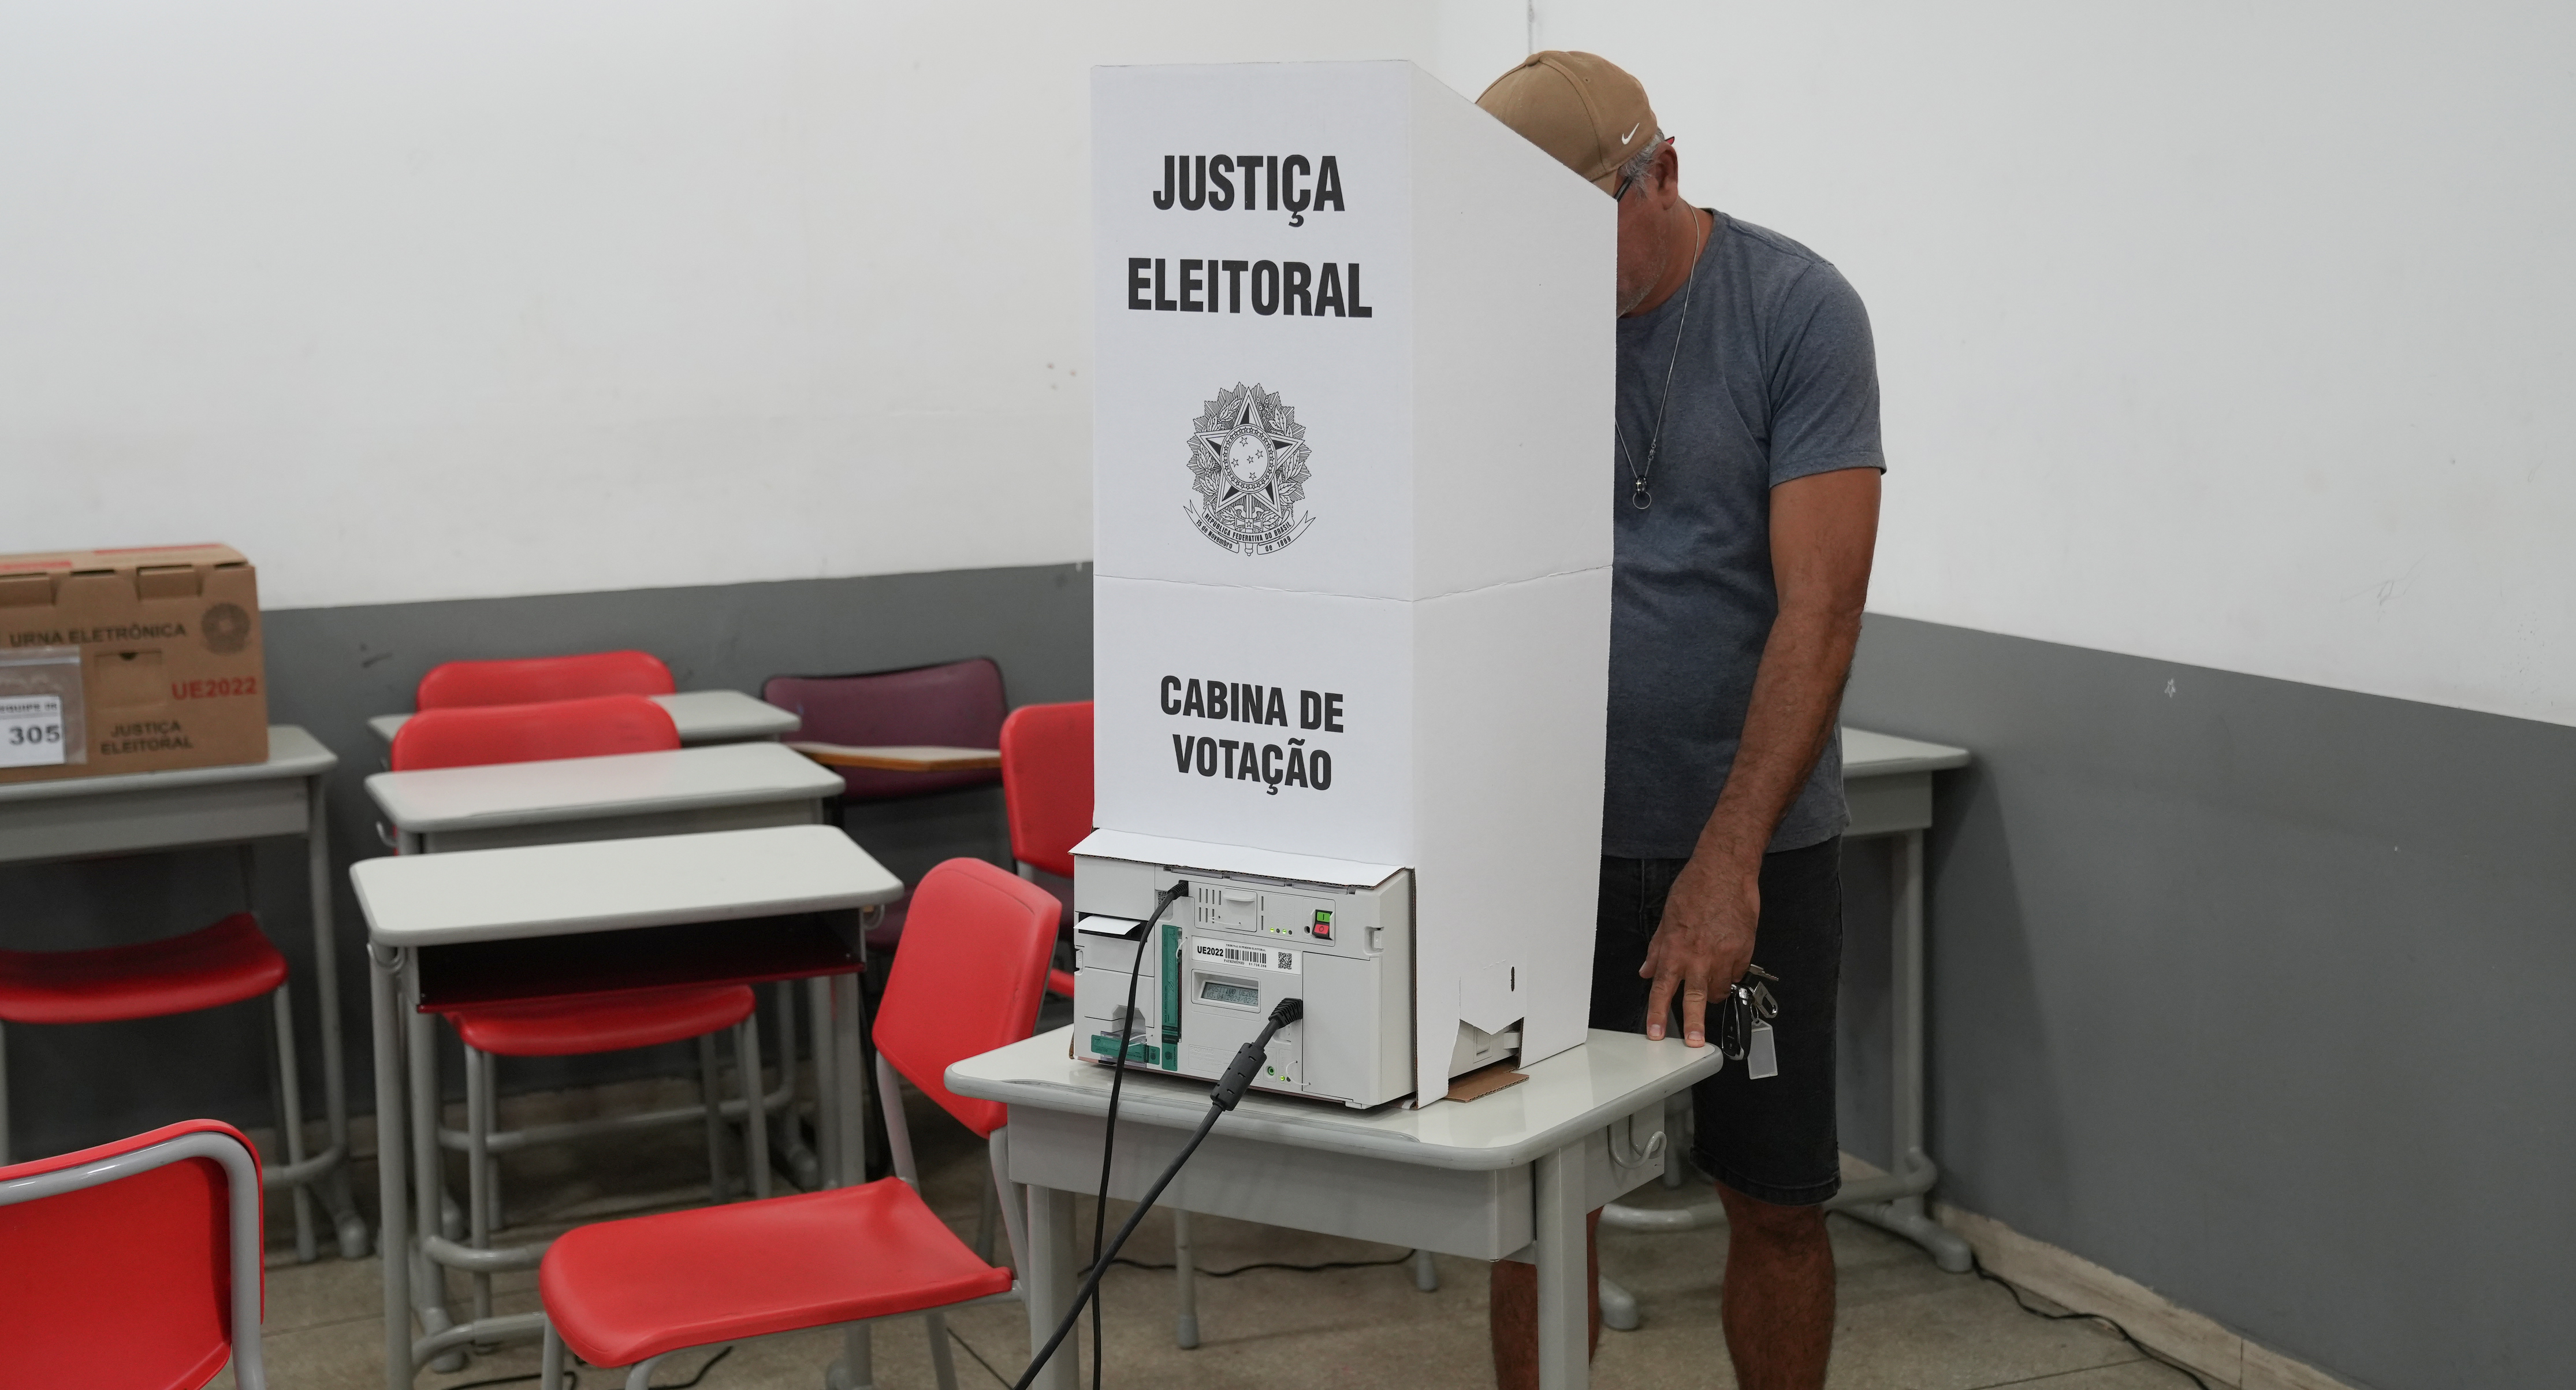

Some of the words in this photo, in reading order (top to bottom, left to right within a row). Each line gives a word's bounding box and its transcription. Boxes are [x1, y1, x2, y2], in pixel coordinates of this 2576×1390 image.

[1153, 154, 1345, 228] JUSTIÇA
[1129, 258, 1372, 318] ELEITORAL
[1204, 513, 1231, 536] REPÚBLICA
[1233, 532, 1263, 542] FEDERATIVA
[1274, 521, 1292, 537] BRASIL
[1208, 530, 1233, 549] Novembro
[1277, 536, 1291, 548] 1889
[9, 630, 64, 647] URNA
[69, 622, 187, 644] ELETRÔNICA
[172, 676, 257, 700] UE2022
[1160, 675, 1288, 727] CABINA
[1301, 690, 1343, 733] DE
[9, 724, 60, 745] 305
[111, 720, 181, 738] JUSTIÇA
[100, 736, 193, 755] ELEITORAL
[1172, 734, 1331, 796] VOTAÇÃO
[1197, 946, 1223, 957] UE2022
[1208, 985, 1236, 995] POSITIVO
